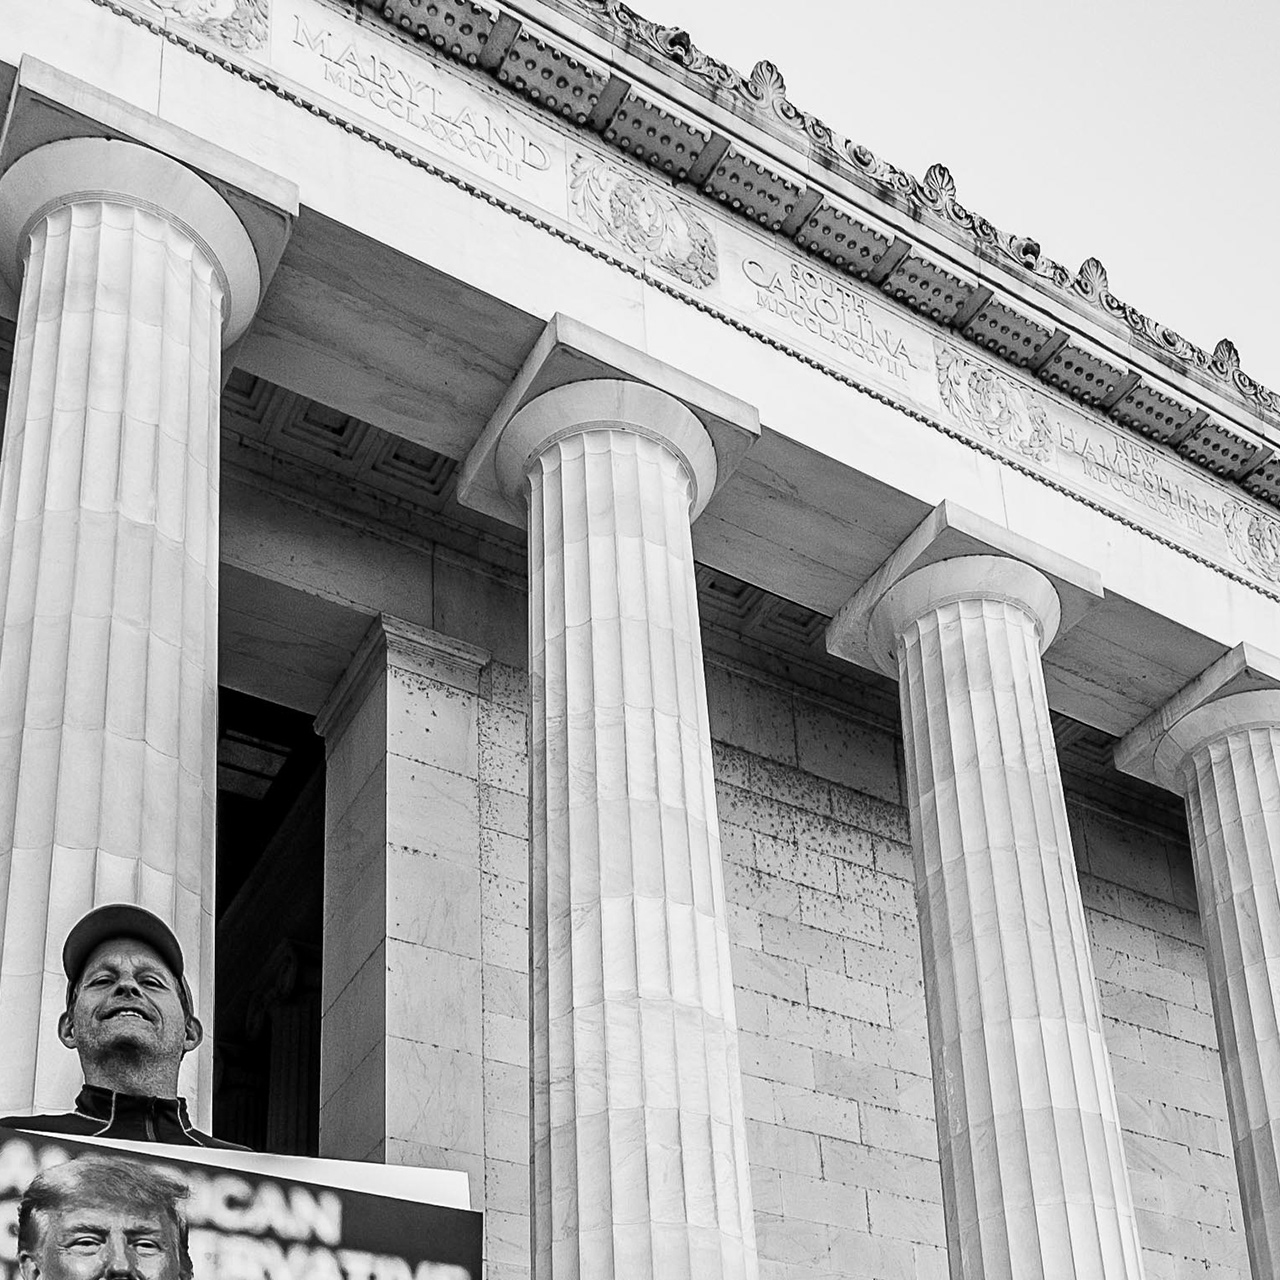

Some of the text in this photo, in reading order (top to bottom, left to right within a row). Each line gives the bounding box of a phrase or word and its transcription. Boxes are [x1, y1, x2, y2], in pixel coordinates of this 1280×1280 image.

[292, 14, 551, 171] MARYLAND
[742, 258, 917, 369] CAROLINA
[790, 263, 869, 317] SOUTH
[1057, 422, 1220, 527] HAMPSHIRE
